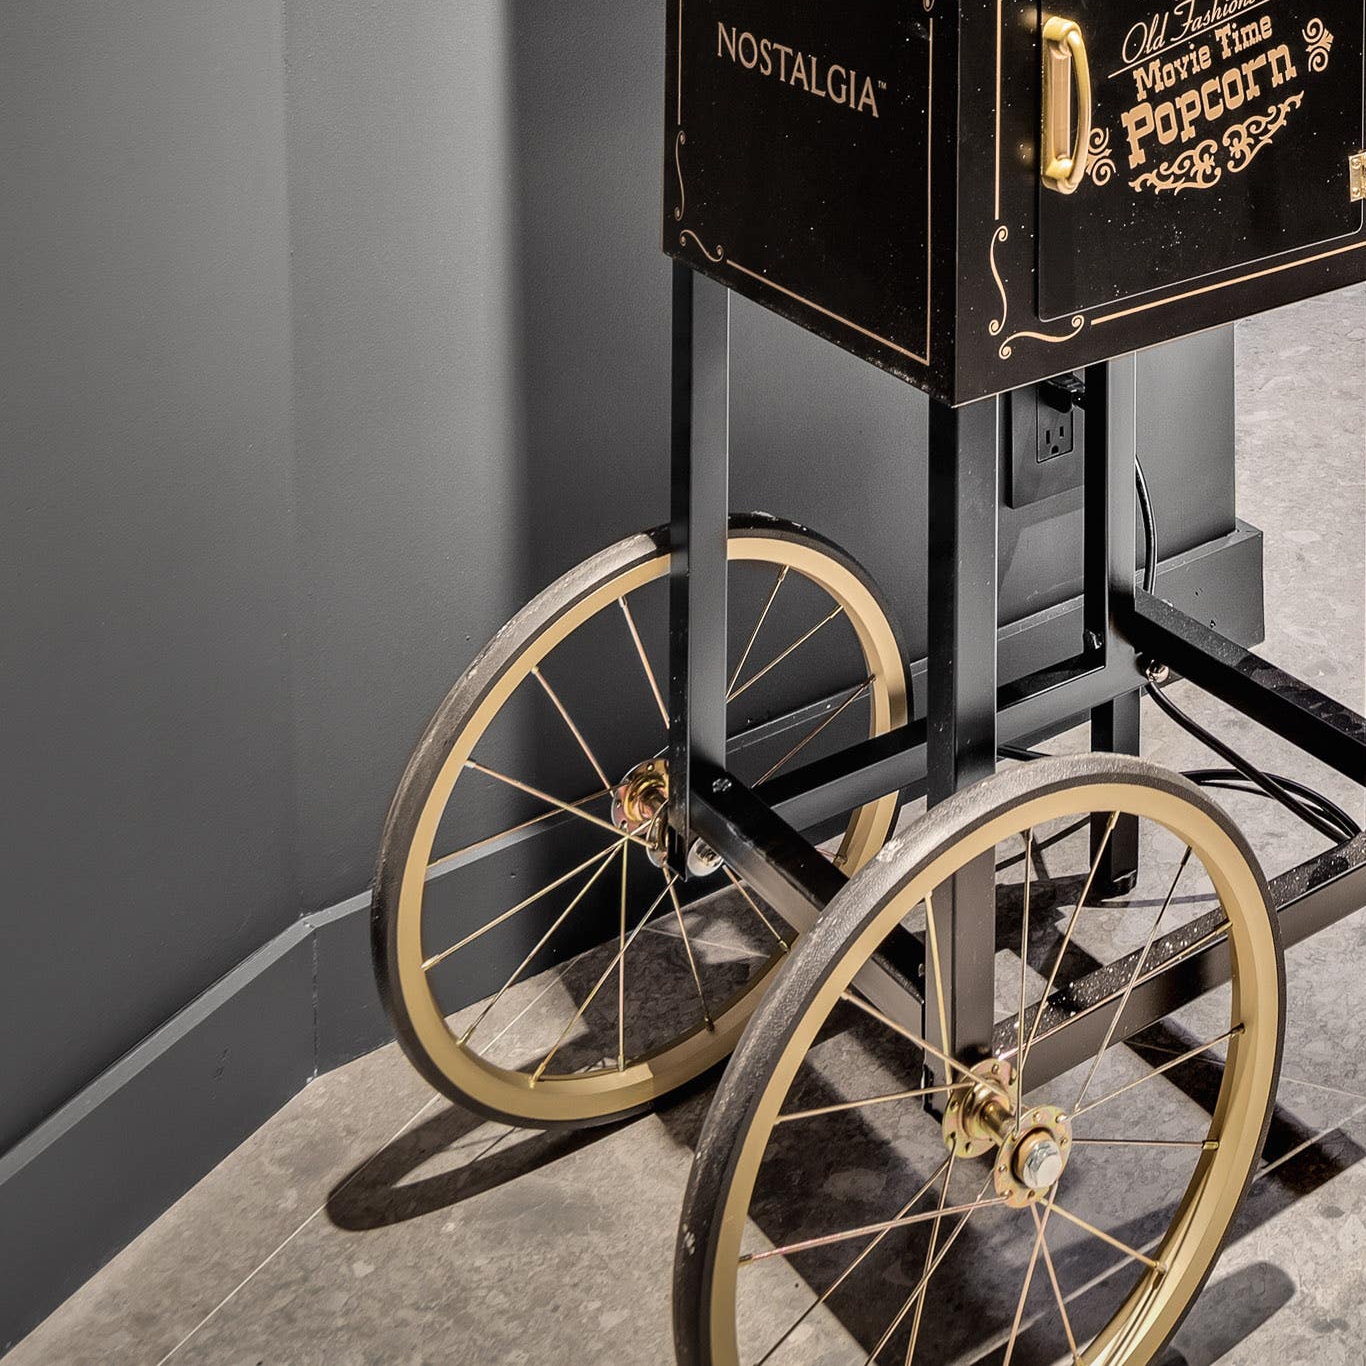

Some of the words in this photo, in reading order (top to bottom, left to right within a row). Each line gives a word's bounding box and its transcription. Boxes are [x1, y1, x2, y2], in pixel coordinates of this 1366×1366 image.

[1122, 11, 1168, 64] Old
[1132, 43, 1212, 102] Movie
[1215, 15, 1274, 58] Time
